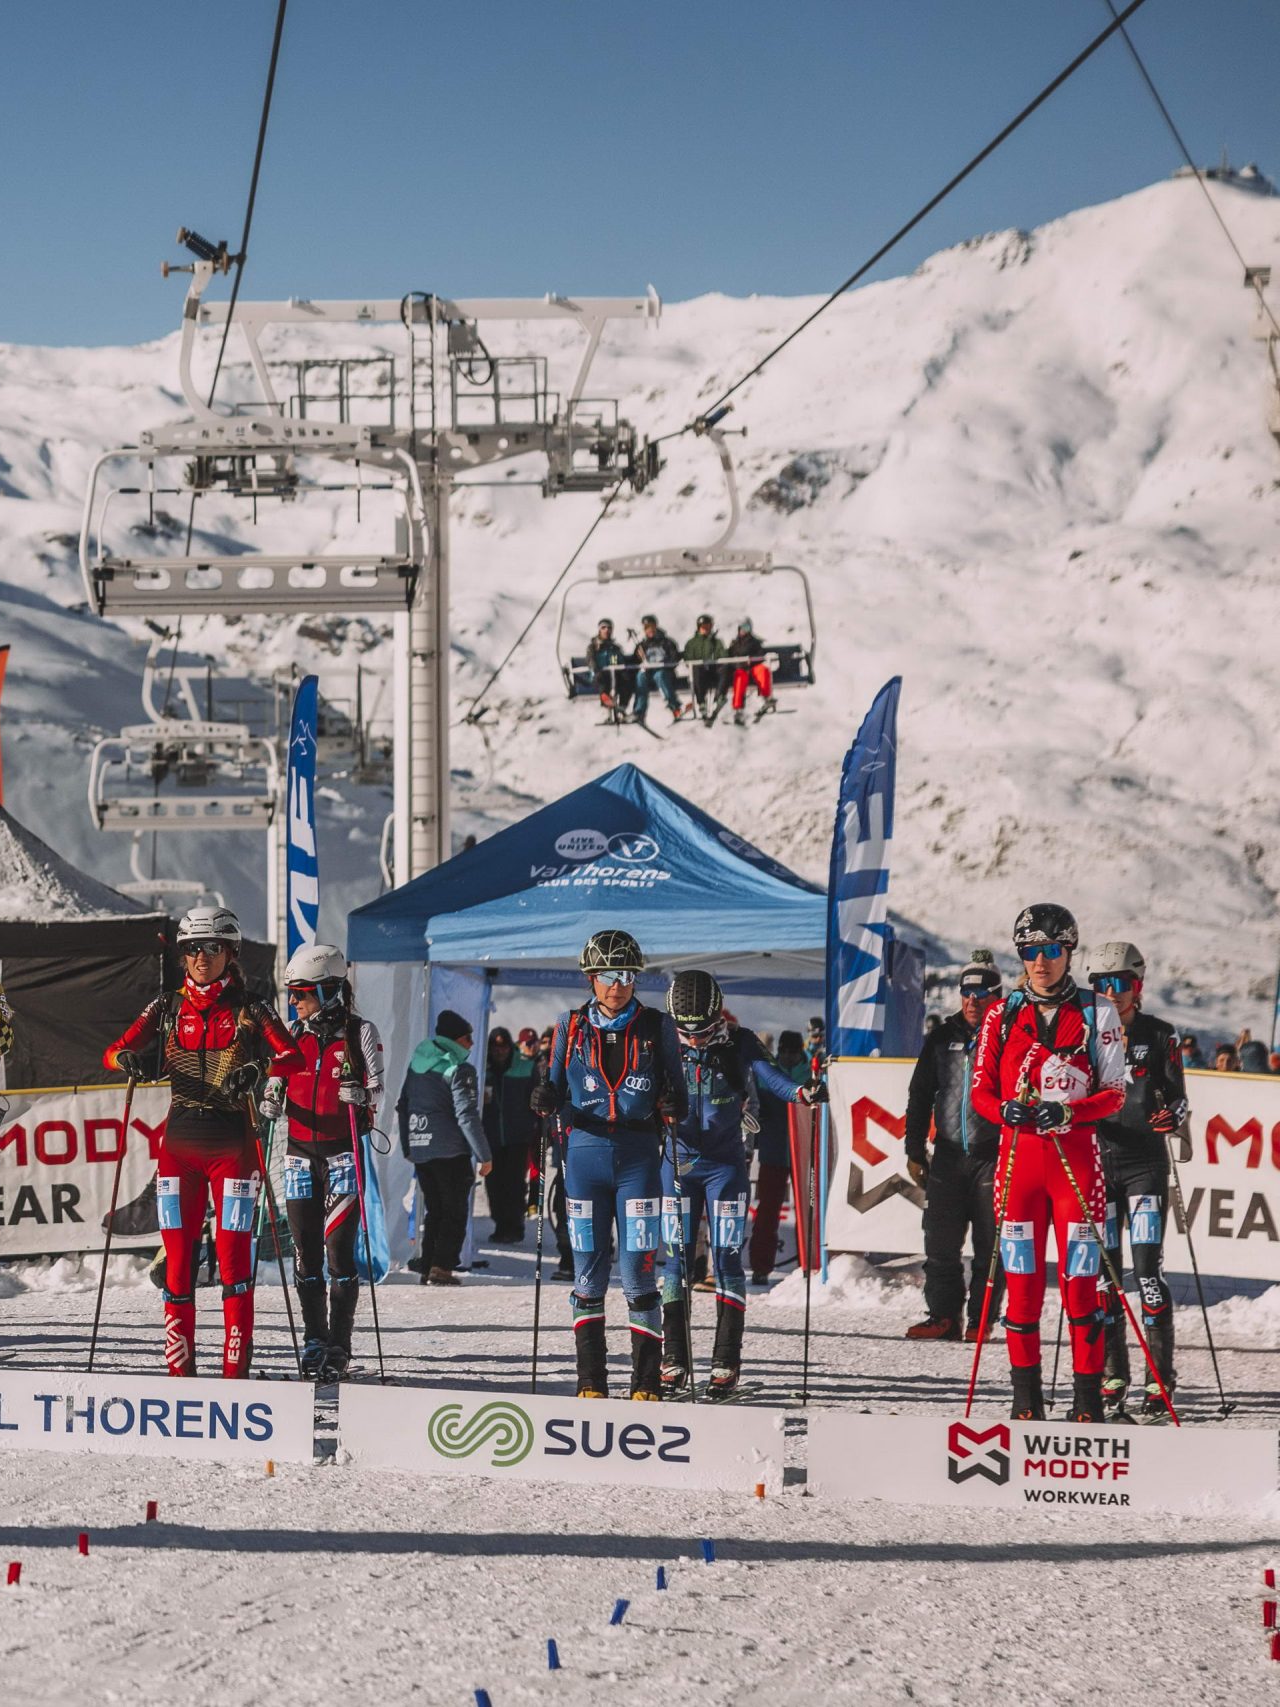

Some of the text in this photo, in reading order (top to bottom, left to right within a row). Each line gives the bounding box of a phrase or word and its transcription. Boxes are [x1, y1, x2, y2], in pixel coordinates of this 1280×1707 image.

[529, 864, 672, 880] Val Thorens
[1044, 1076, 1077, 1091] SUI
[581, 1098, 605, 1107] SUUNTO
[230, 1199, 246, 1231] 4.1
[1132, 1213, 1156, 1242] 20.1
[635, 1218, 653, 1250] 3.1
[1005, 1241, 1025, 1273] 2.1
[1076, 1243, 1093, 1274] 2.1
[228, 1325, 242, 1364] ESP
[34, 1395, 274, 1442] THORENS
[1023, 1434, 1131, 1459] WÜRTH
[1023, 1458, 1130, 1481] MODYF
[1023, 1488, 1131, 1506] WORKWEAR
